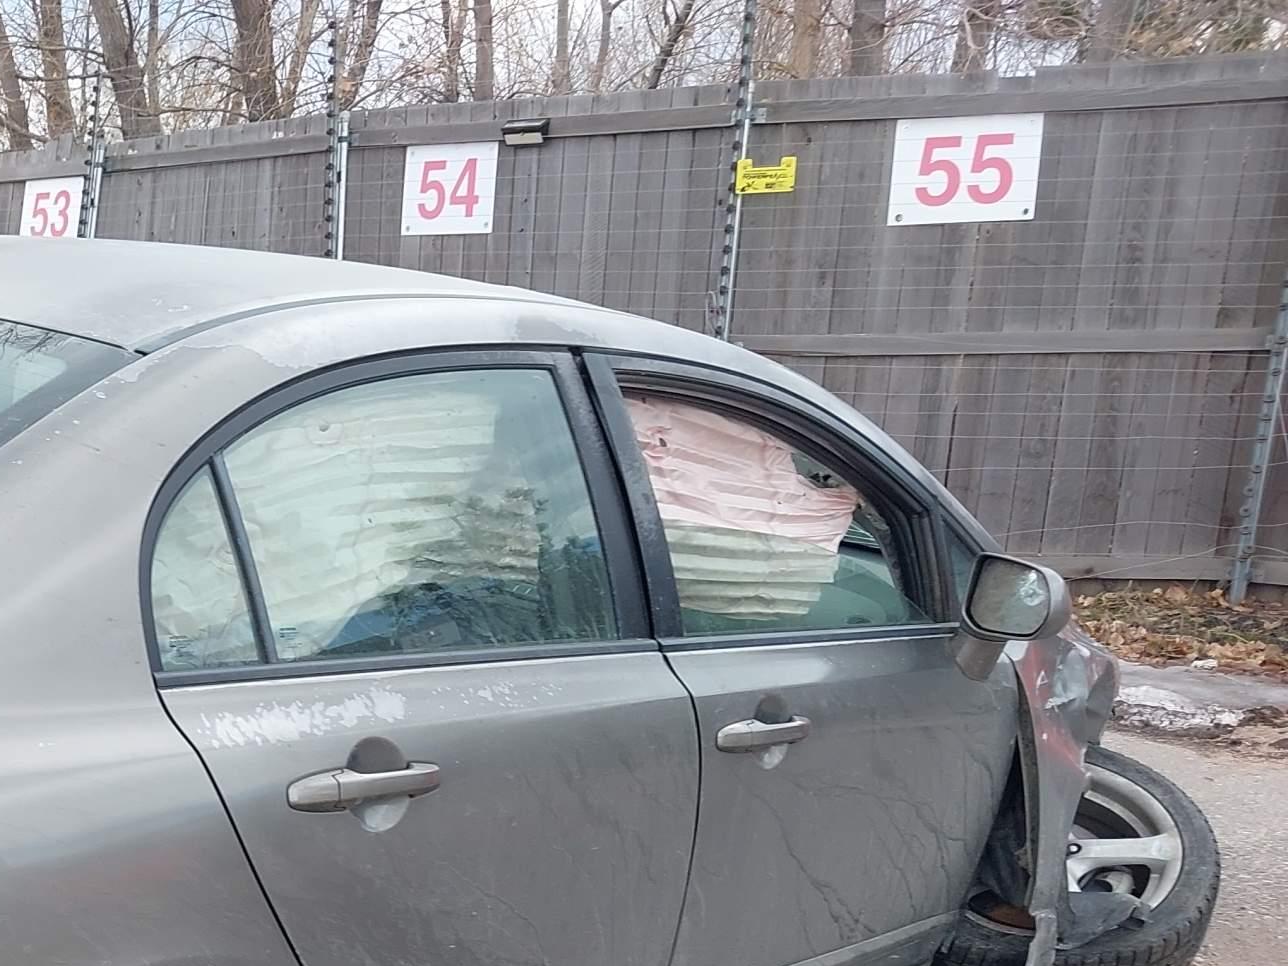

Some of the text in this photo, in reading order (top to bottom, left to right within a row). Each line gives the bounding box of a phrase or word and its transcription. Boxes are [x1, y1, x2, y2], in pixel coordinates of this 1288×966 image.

[417, 157, 480, 220] 54
[914, 133, 1016, 207] 55
[29, 189, 71, 237] 53
